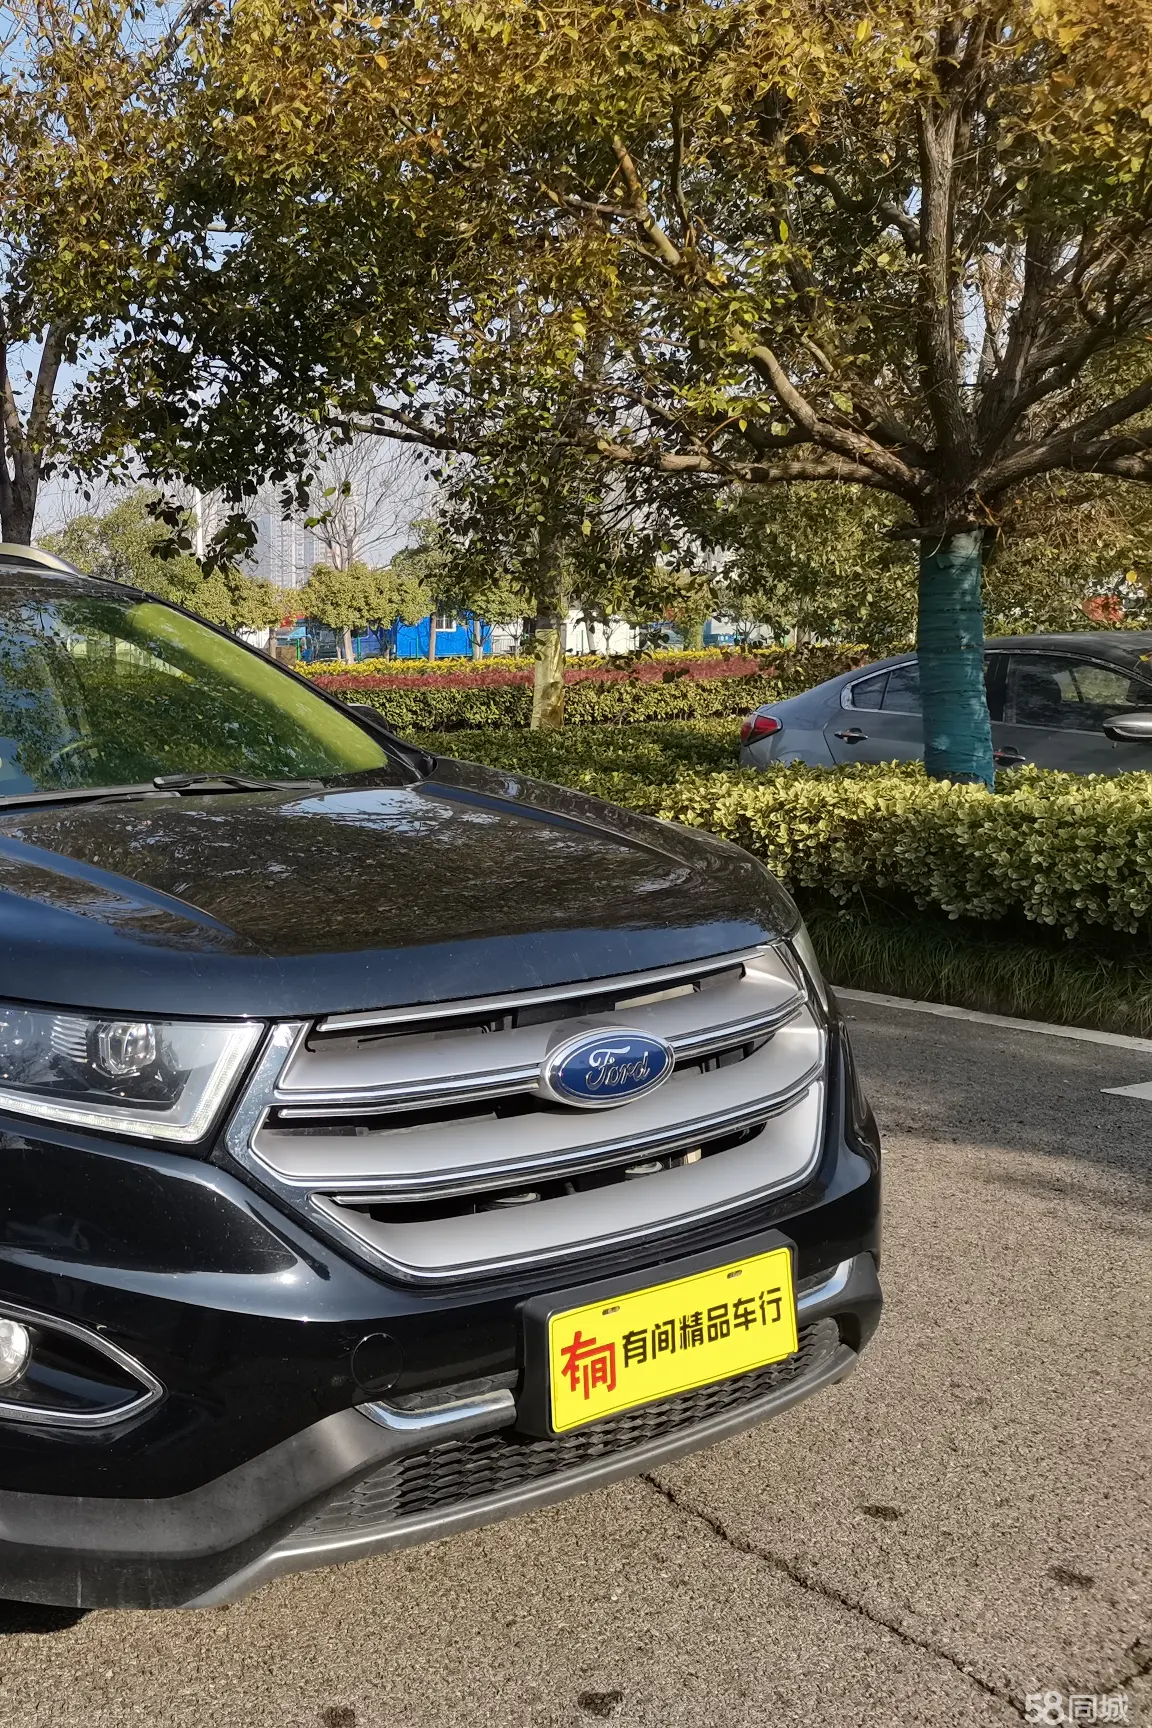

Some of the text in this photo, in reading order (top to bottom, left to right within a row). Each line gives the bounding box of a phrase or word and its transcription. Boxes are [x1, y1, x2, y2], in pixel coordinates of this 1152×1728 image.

[585, 1045, 651, 1091] Ford
[622, 1287, 783, 1368] 有间精品车行
